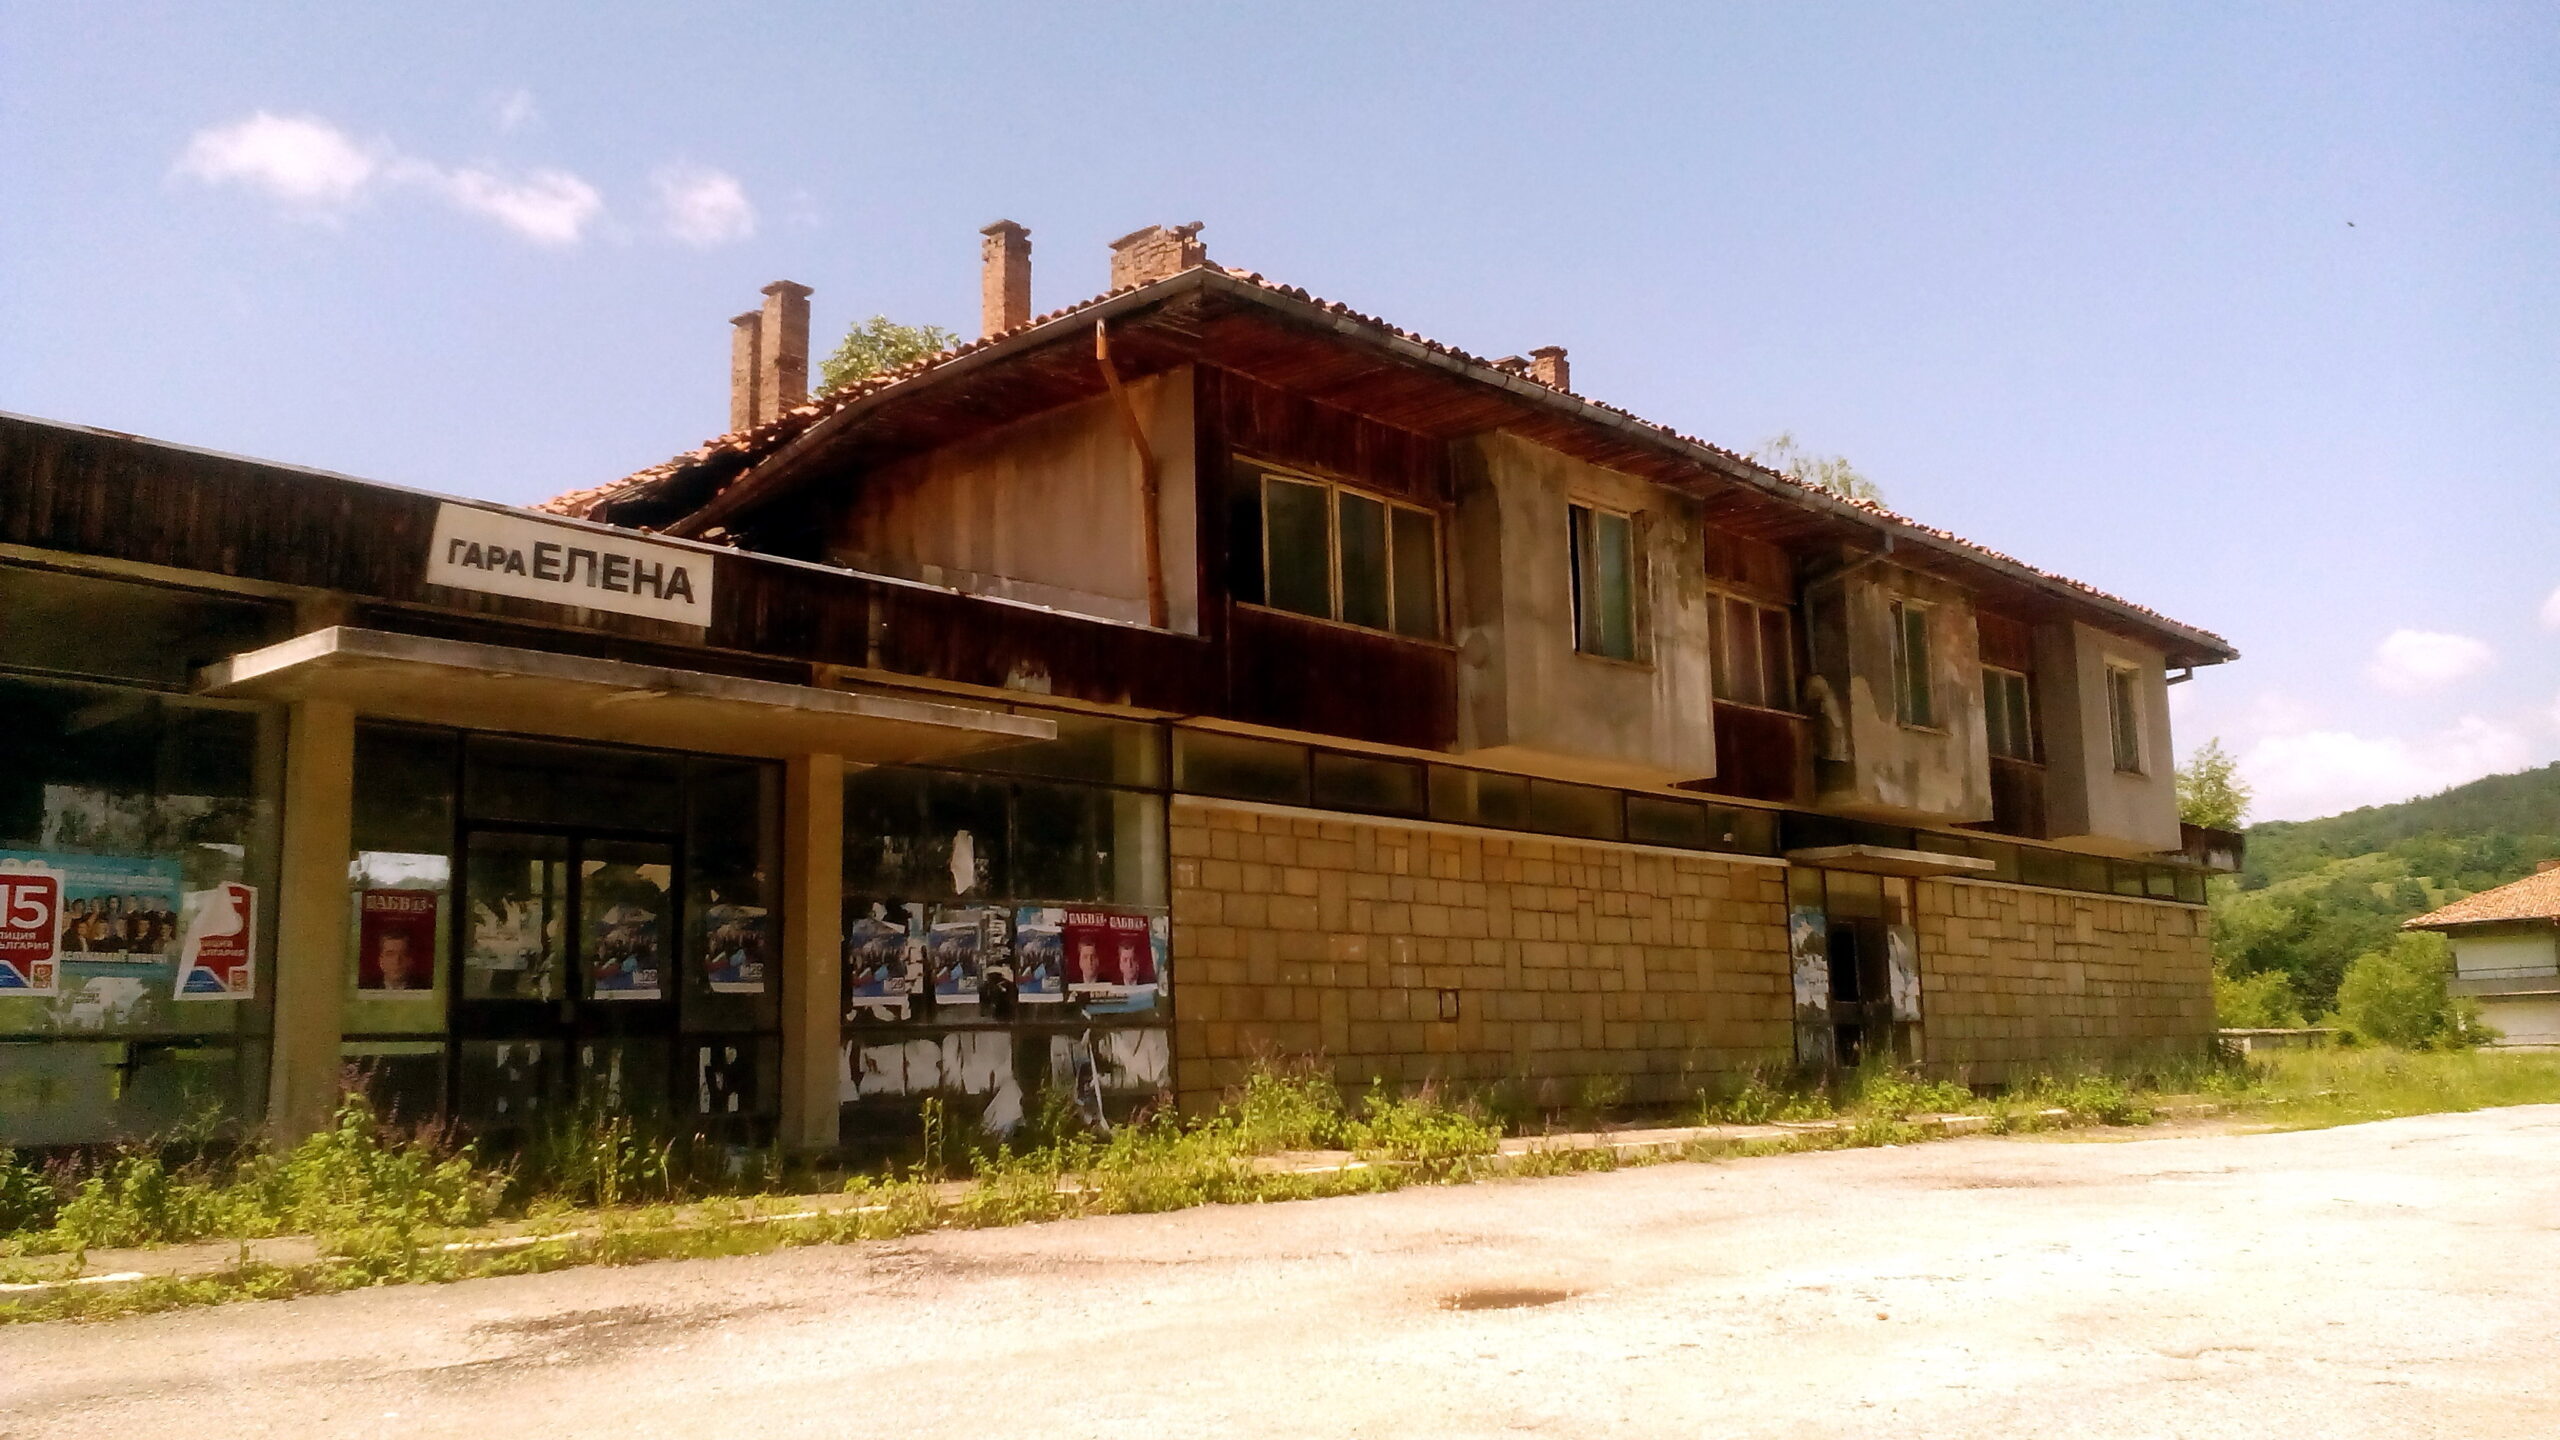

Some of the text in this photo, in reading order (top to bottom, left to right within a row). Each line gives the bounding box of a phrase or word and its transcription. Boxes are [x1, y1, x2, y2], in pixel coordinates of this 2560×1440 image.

[447, 538, 695, 604] ГАРА ЕЛЕНА
[0, 884, 48, 929] 15
